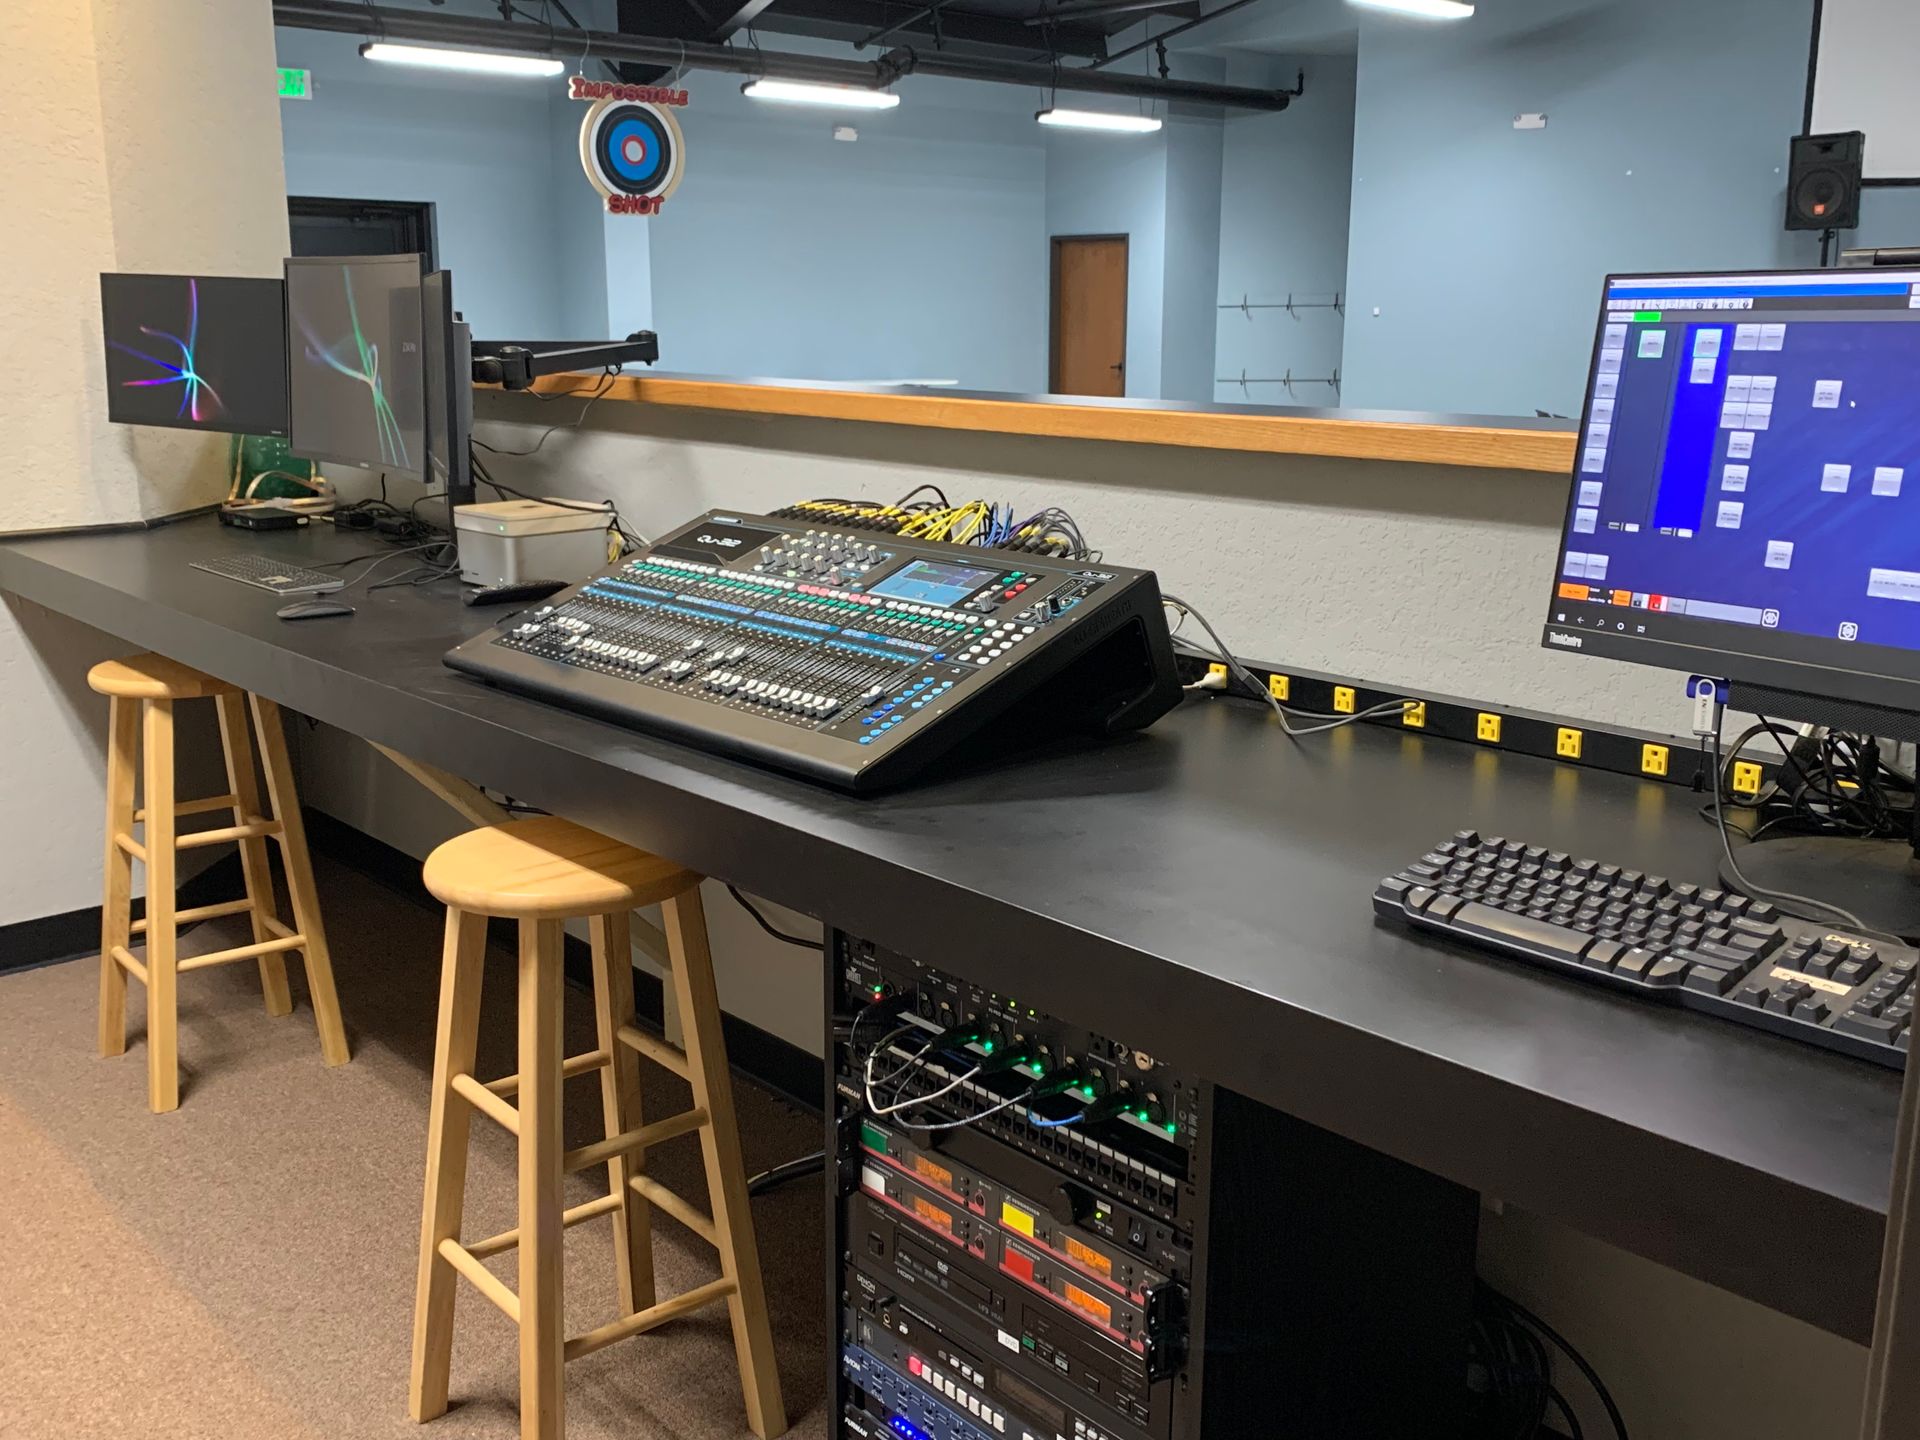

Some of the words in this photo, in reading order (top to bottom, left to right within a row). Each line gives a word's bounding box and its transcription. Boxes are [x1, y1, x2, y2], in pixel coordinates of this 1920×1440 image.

[571, 77, 689, 107] IMPOSSIBLE
[608, 193, 665, 215] SHOT
[837, 1083, 861, 1101] FURMAN
[856, 1273, 876, 1292] DENON
